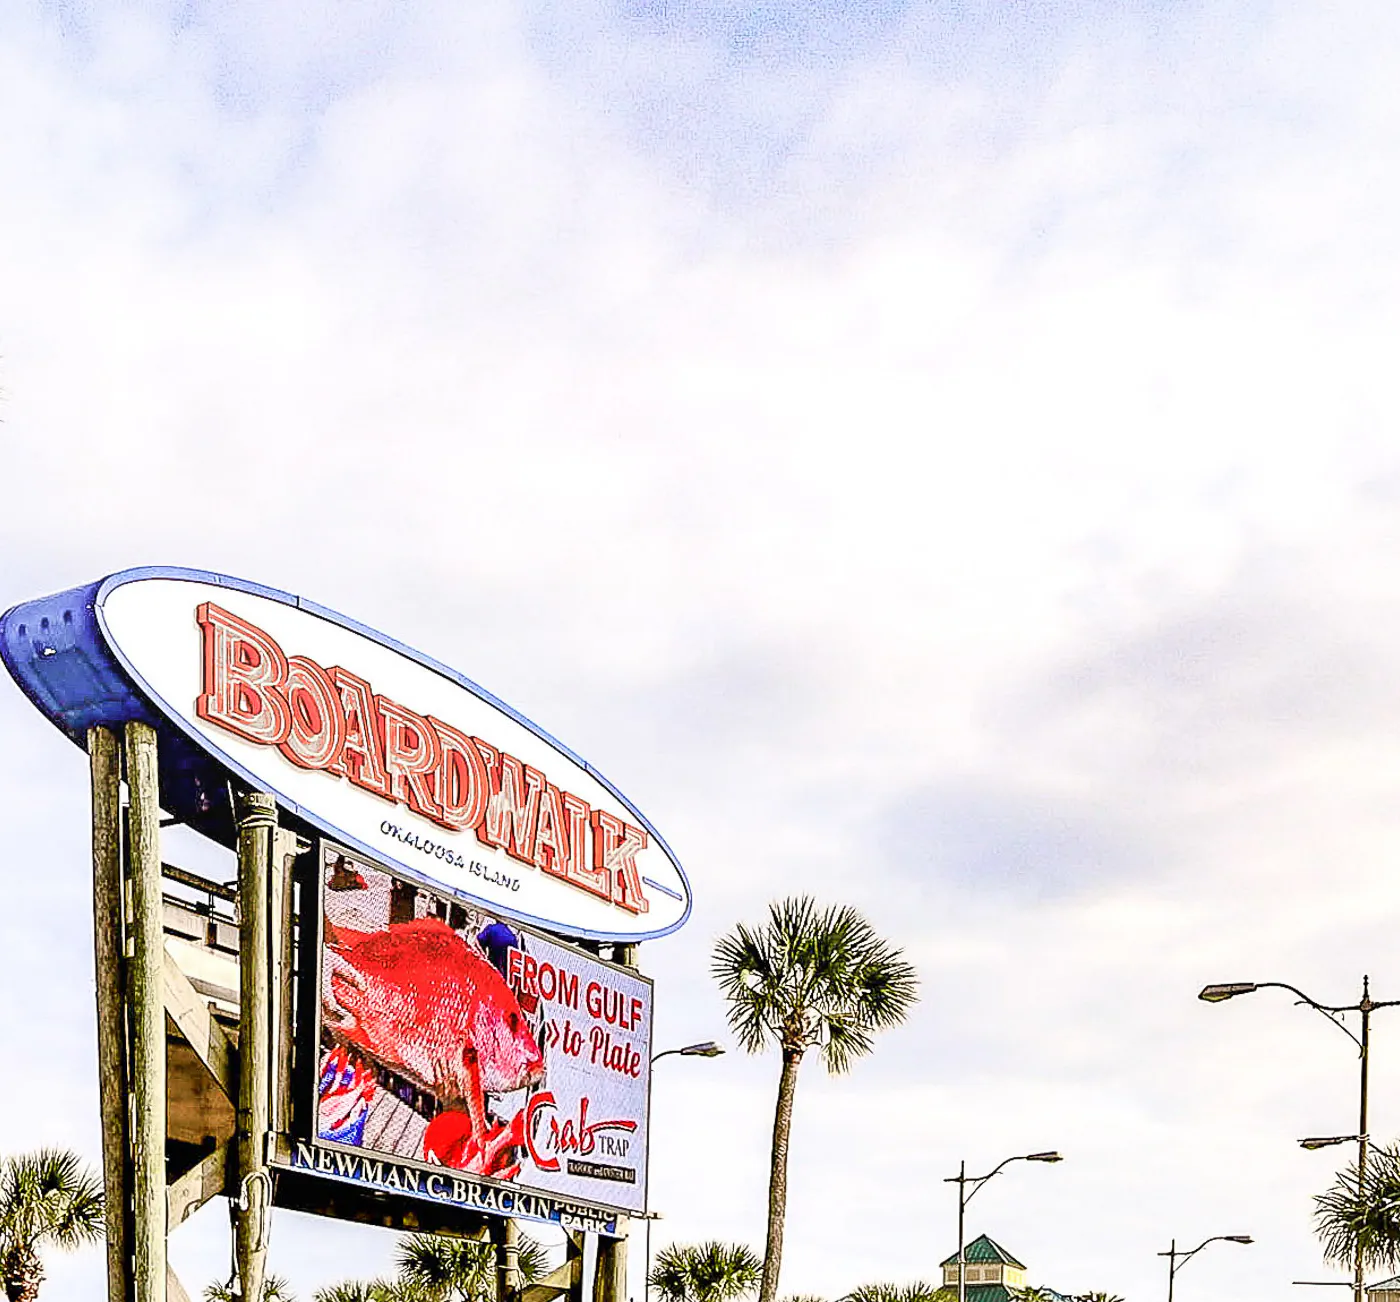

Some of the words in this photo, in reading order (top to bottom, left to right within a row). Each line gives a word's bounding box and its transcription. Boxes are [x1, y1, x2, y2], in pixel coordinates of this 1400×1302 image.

[194, 601, 650, 914] BOARDWALK
[380, 820, 465, 869] OKALOOSA
[469, 860, 521, 892] ISLAND
[508, 947, 579, 1010] FROM
[586, 981, 643, 1032] GULF
[562, 1020, 585, 1057] to
[590, 1025, 641, 1079] Plate
[526, 1091, 638, 1172] Crab
[599, 1135, 630, 1158] TRAP
[296, 1142, 420, 1193] NEWMAN
[451, 1180, 550, 1220] BRACKIN
[554, 1201, 615, 1222] PUBLIC
[560, 1212, 608, 1234] PARK
